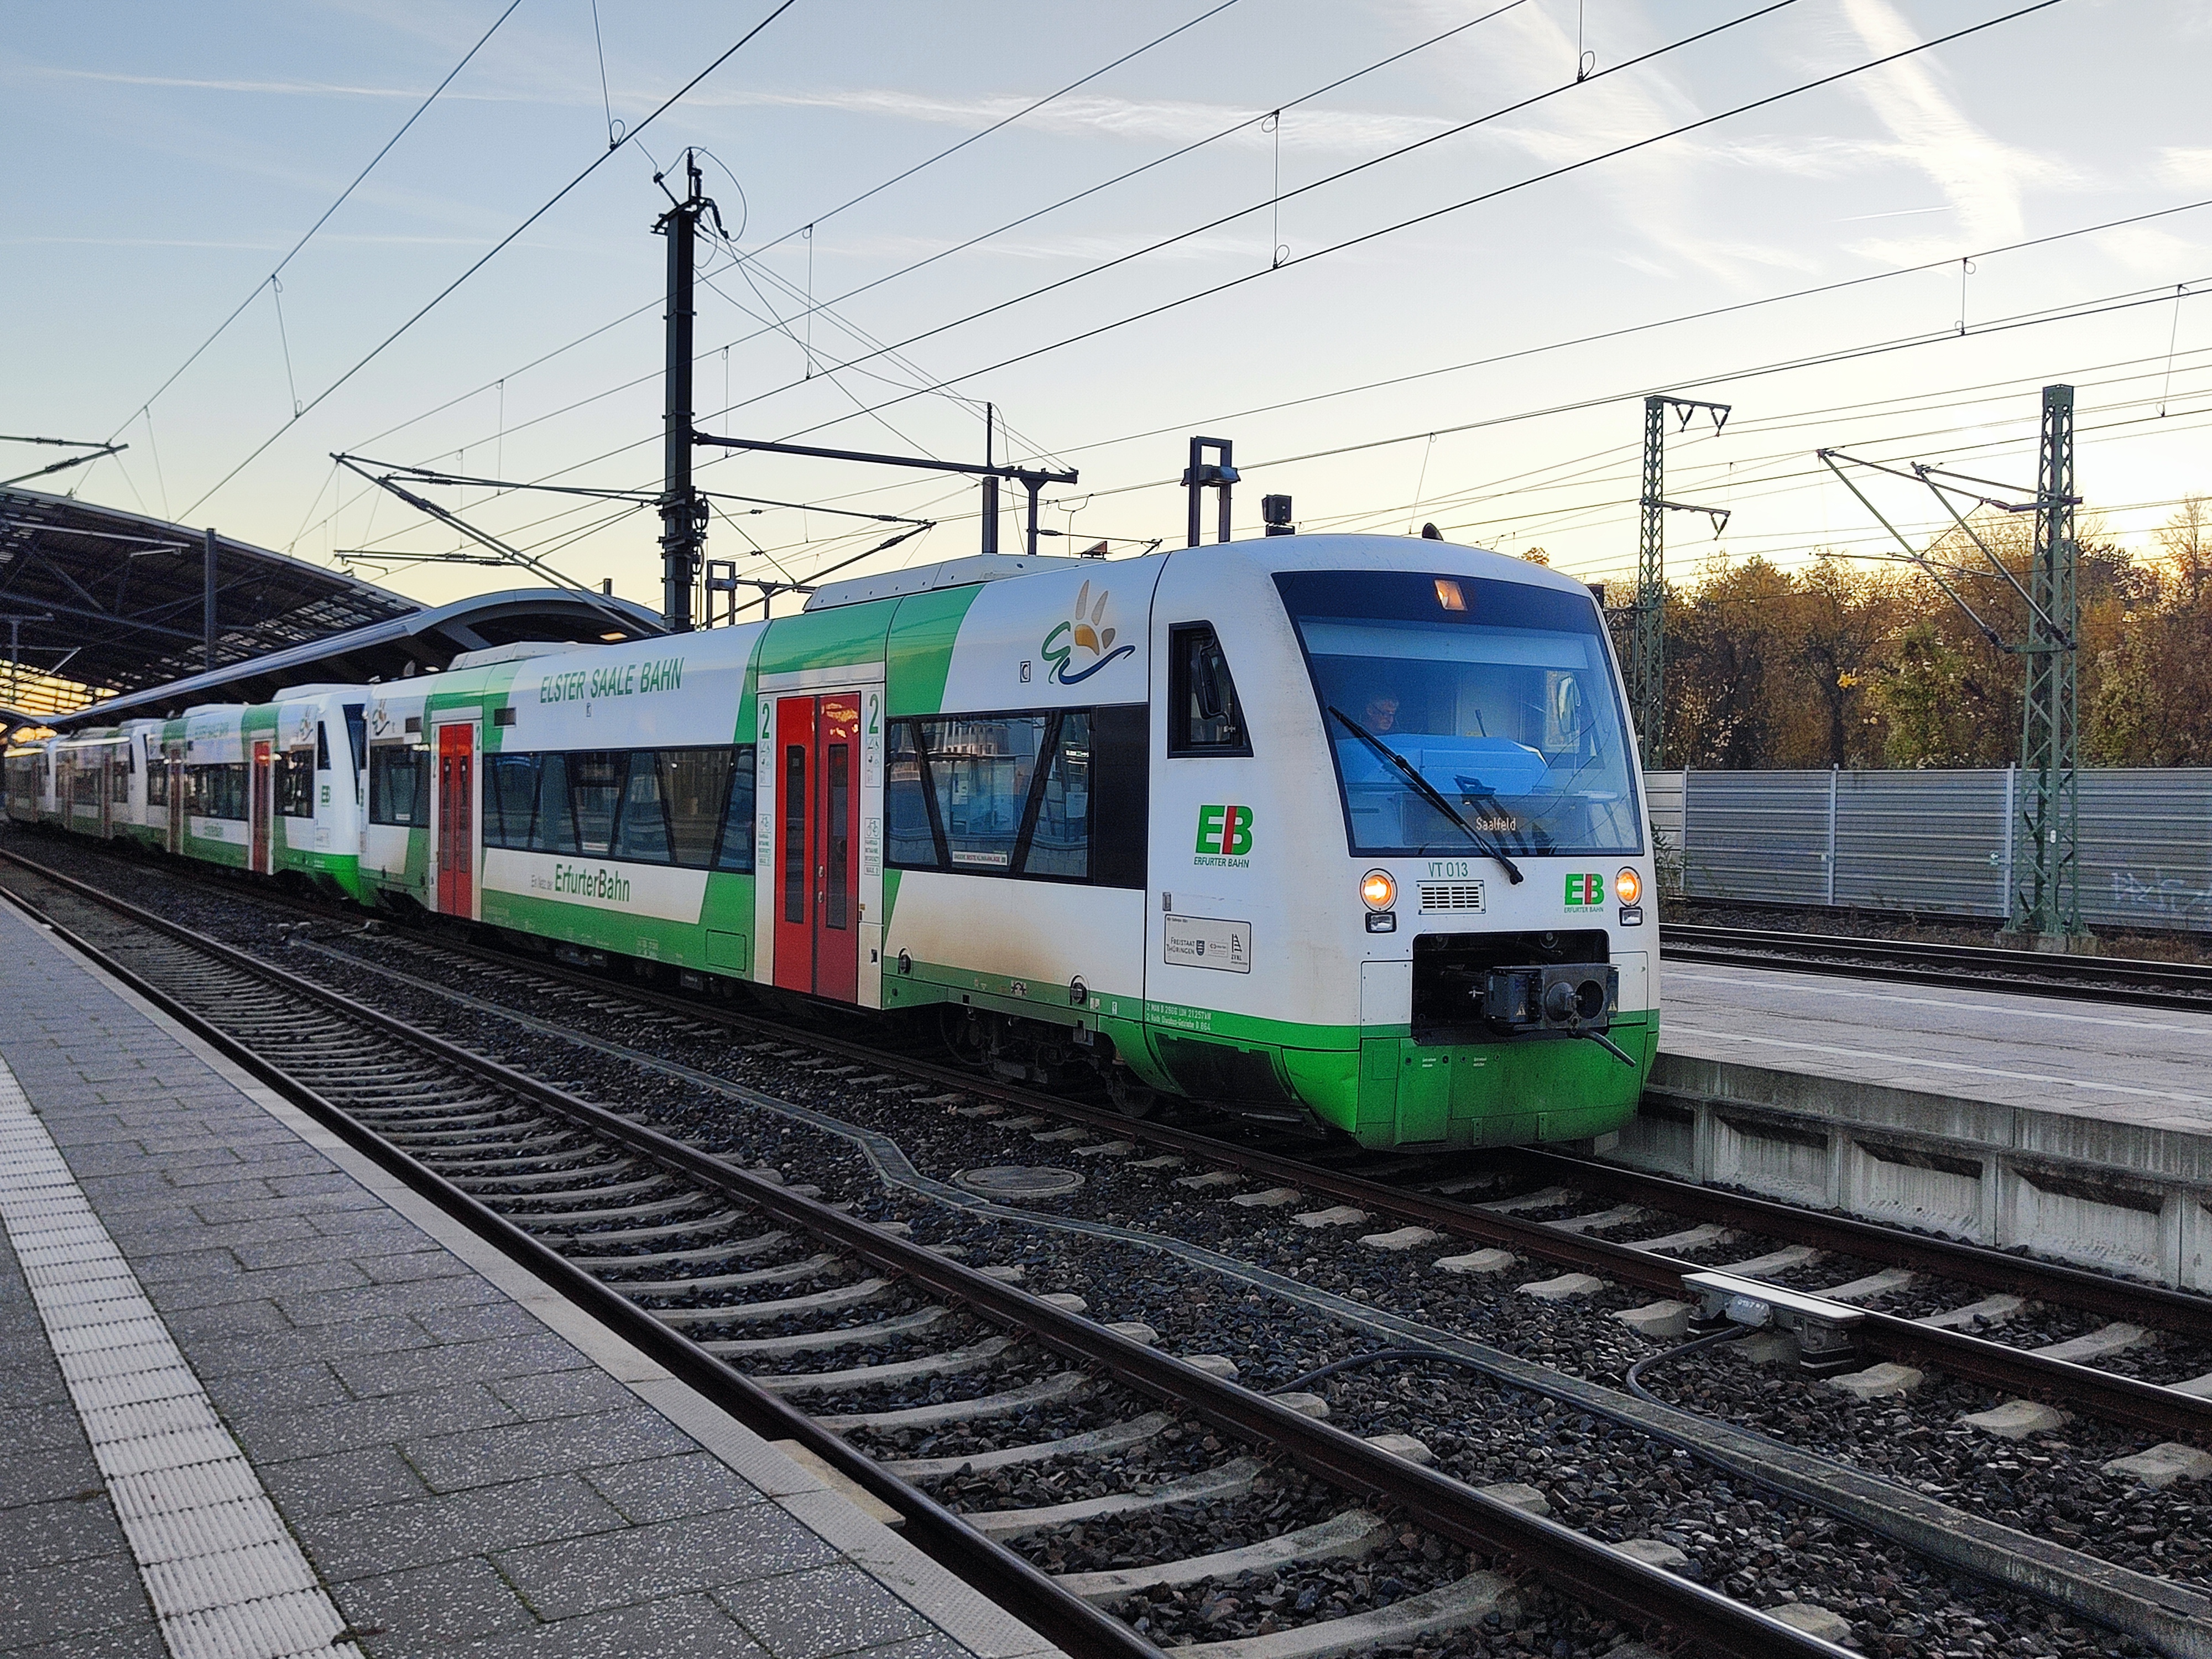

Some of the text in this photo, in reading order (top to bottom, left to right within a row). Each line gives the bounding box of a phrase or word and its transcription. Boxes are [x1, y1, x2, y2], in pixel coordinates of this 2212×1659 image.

[540, 657, 685, 703] ELSTER SAALE BAHN
[762, 703, 770, 739] 2
[871, 693, 879, 734] 2
[1476, 817, 1516, 831] Saalfeld
[1194, 857, 1249, 868] ERFURTER BAHN
[1428, 862, 1468, 877] VT 013
[555, 864, 630, 902] ErfurterBahn
